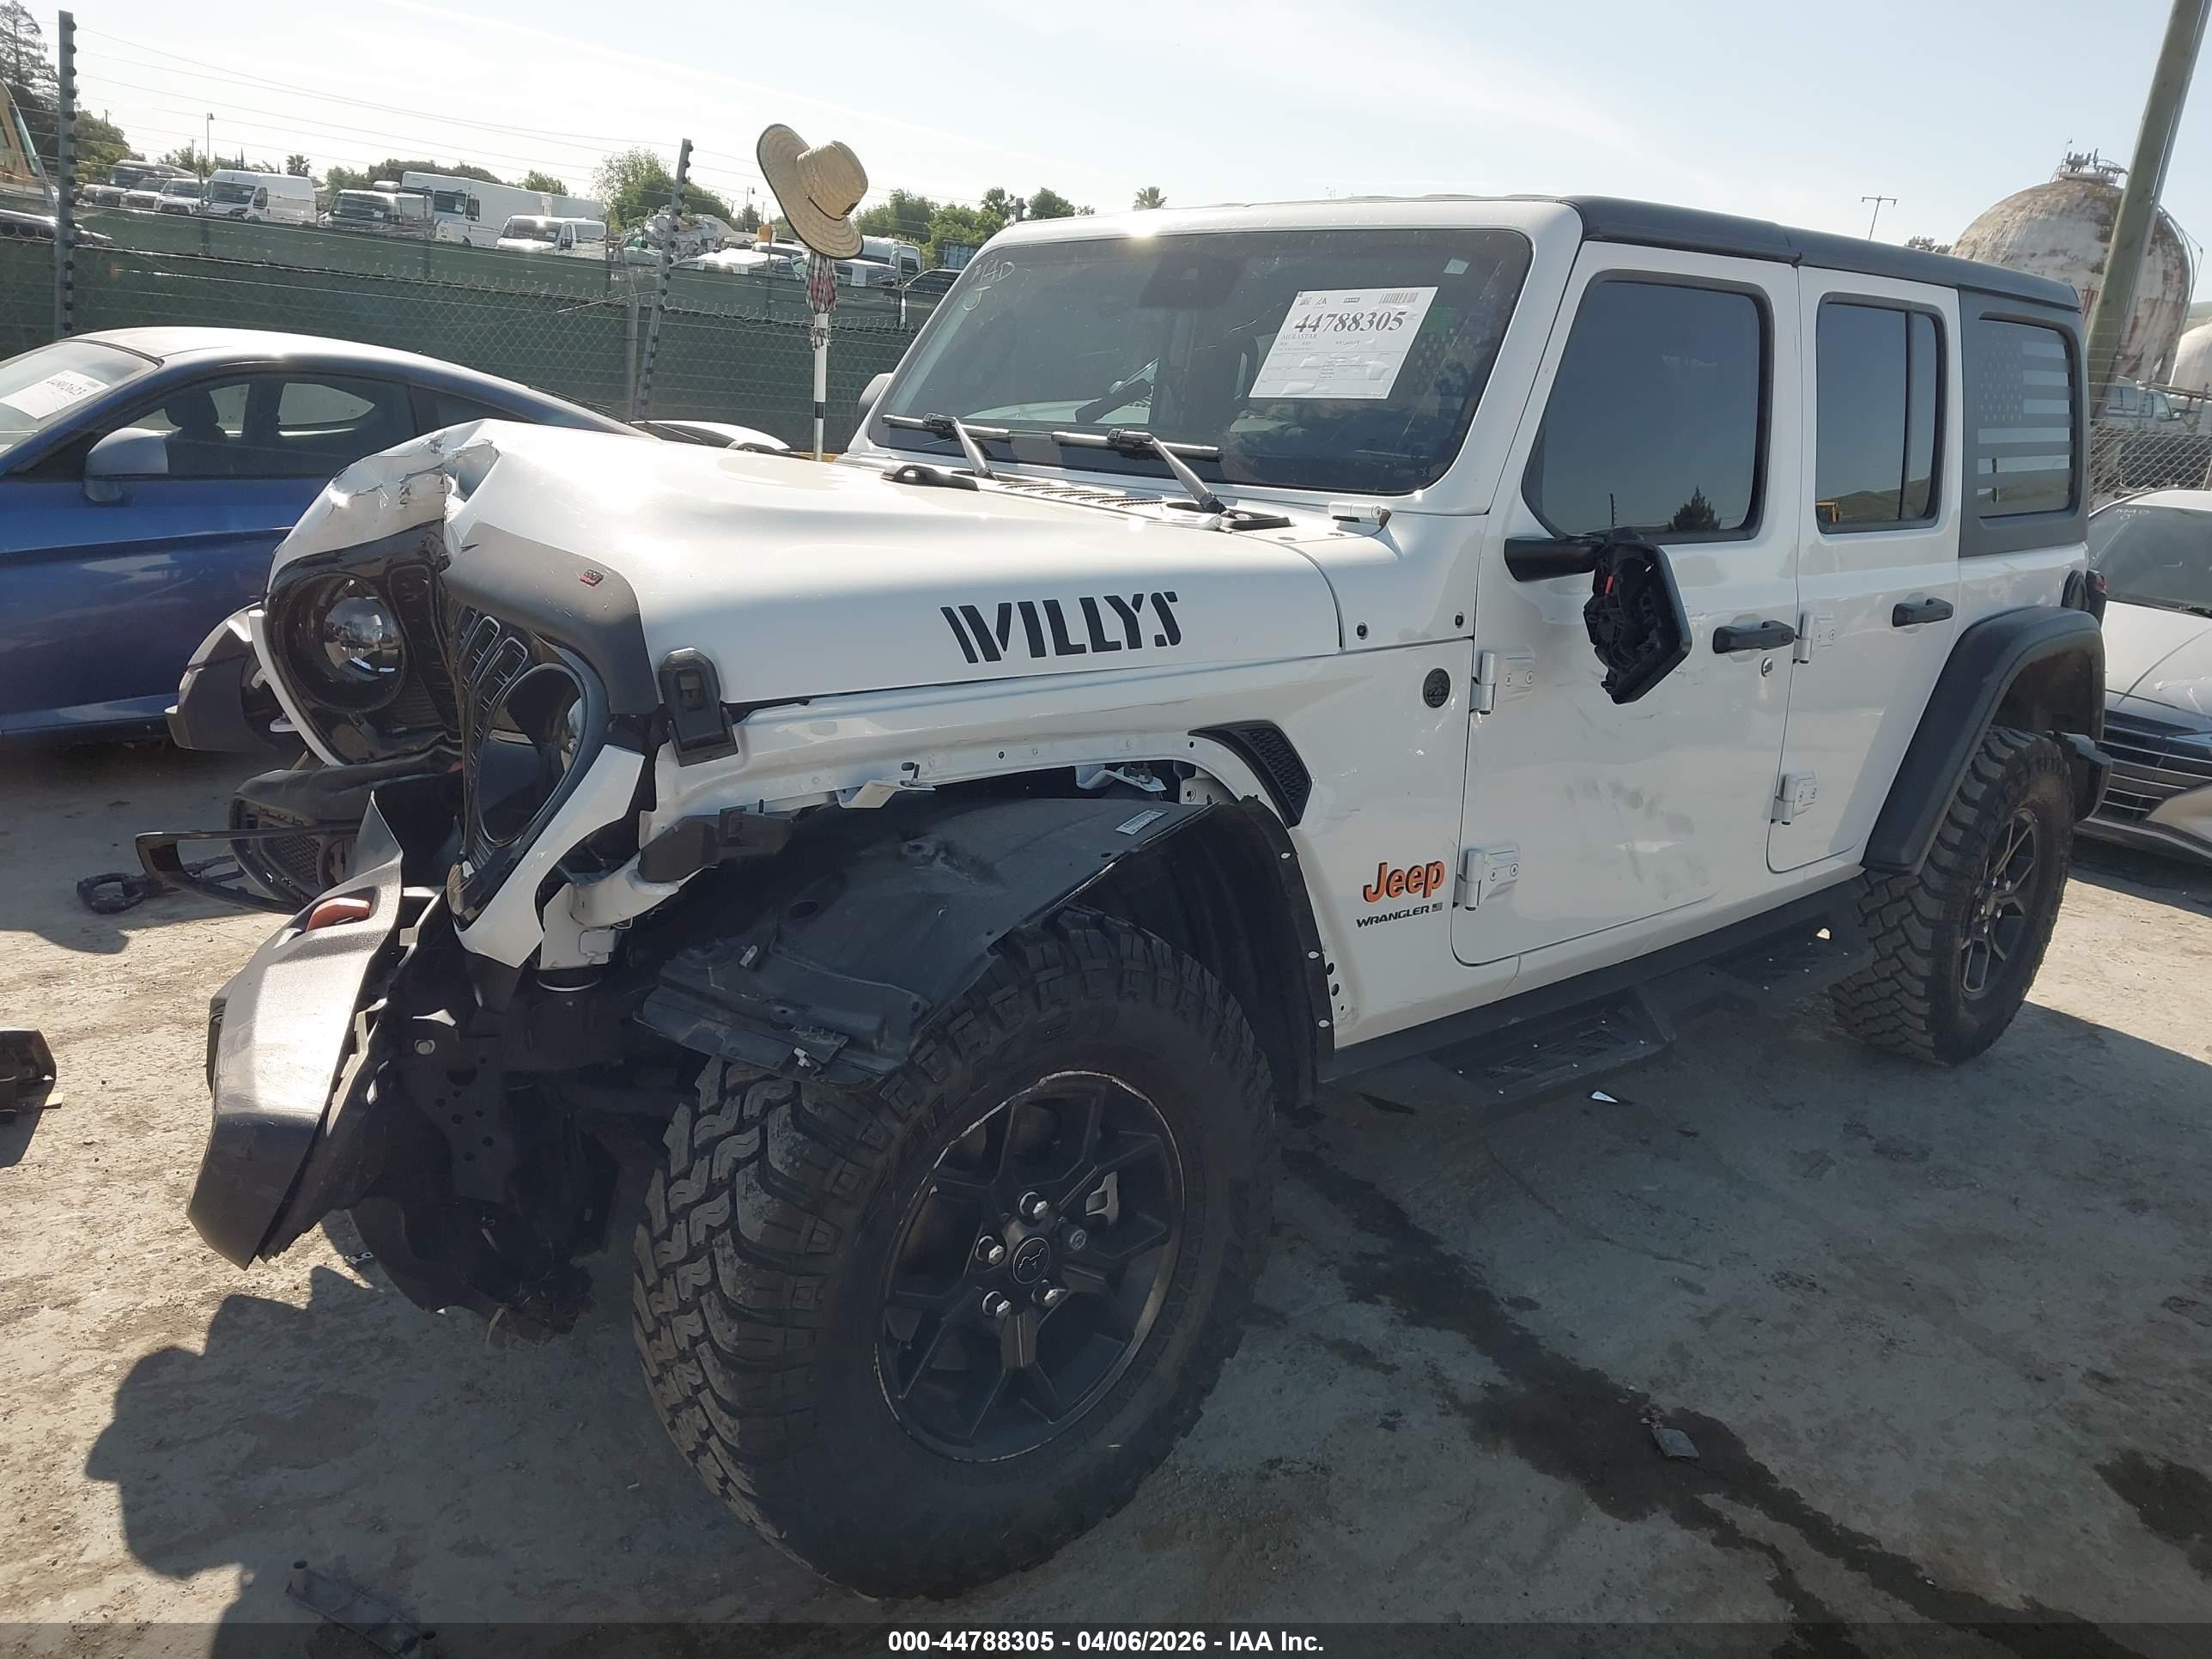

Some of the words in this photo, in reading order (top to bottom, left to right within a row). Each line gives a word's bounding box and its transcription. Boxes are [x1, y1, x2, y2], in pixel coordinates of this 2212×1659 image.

[1294, 311, 1407, 332] 44788305
[939, 592, 1182, 664] WILLYS
[1363, 860, 1445, 902] Jeep
[1356, 905, 1430, 928] WRANGLER
